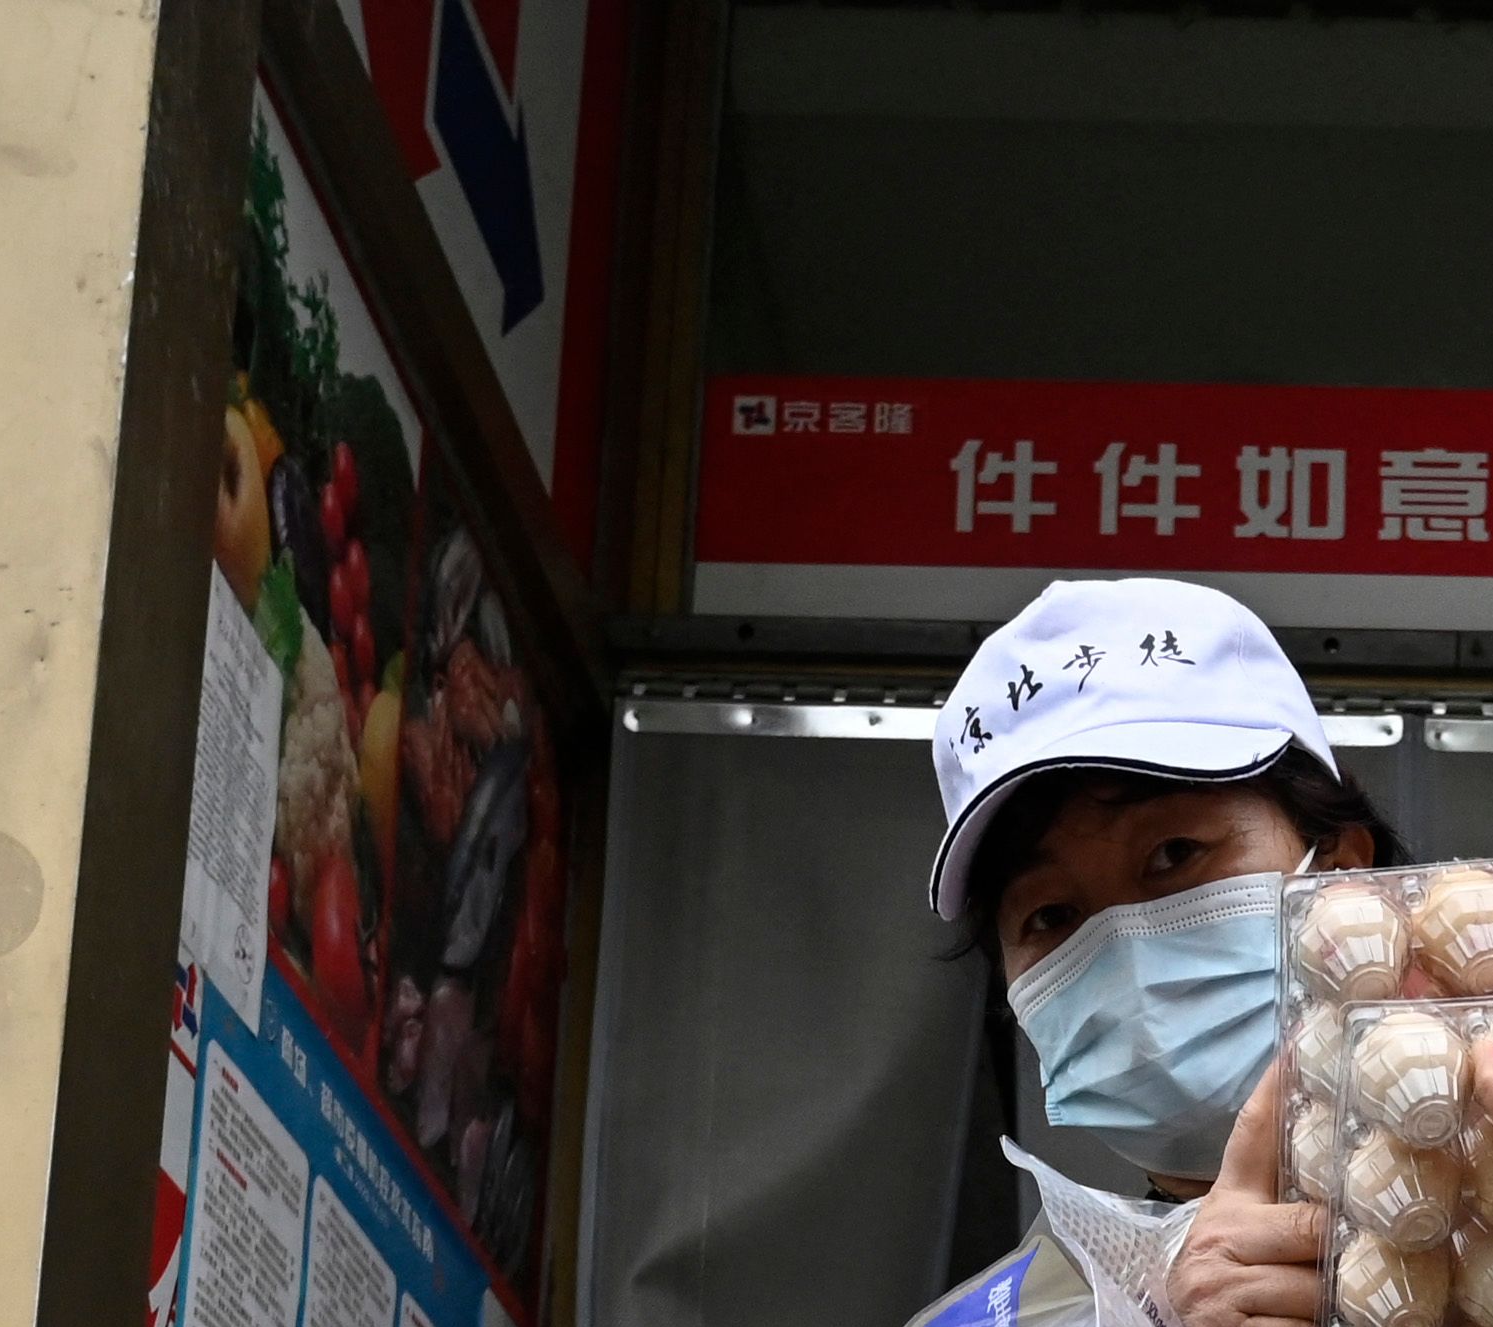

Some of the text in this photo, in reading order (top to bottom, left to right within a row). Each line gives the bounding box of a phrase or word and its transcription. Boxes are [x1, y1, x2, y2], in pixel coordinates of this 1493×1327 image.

[781, 401, 914, 436] 京客隆
[950, 439, 1492, 543] 件件如意
